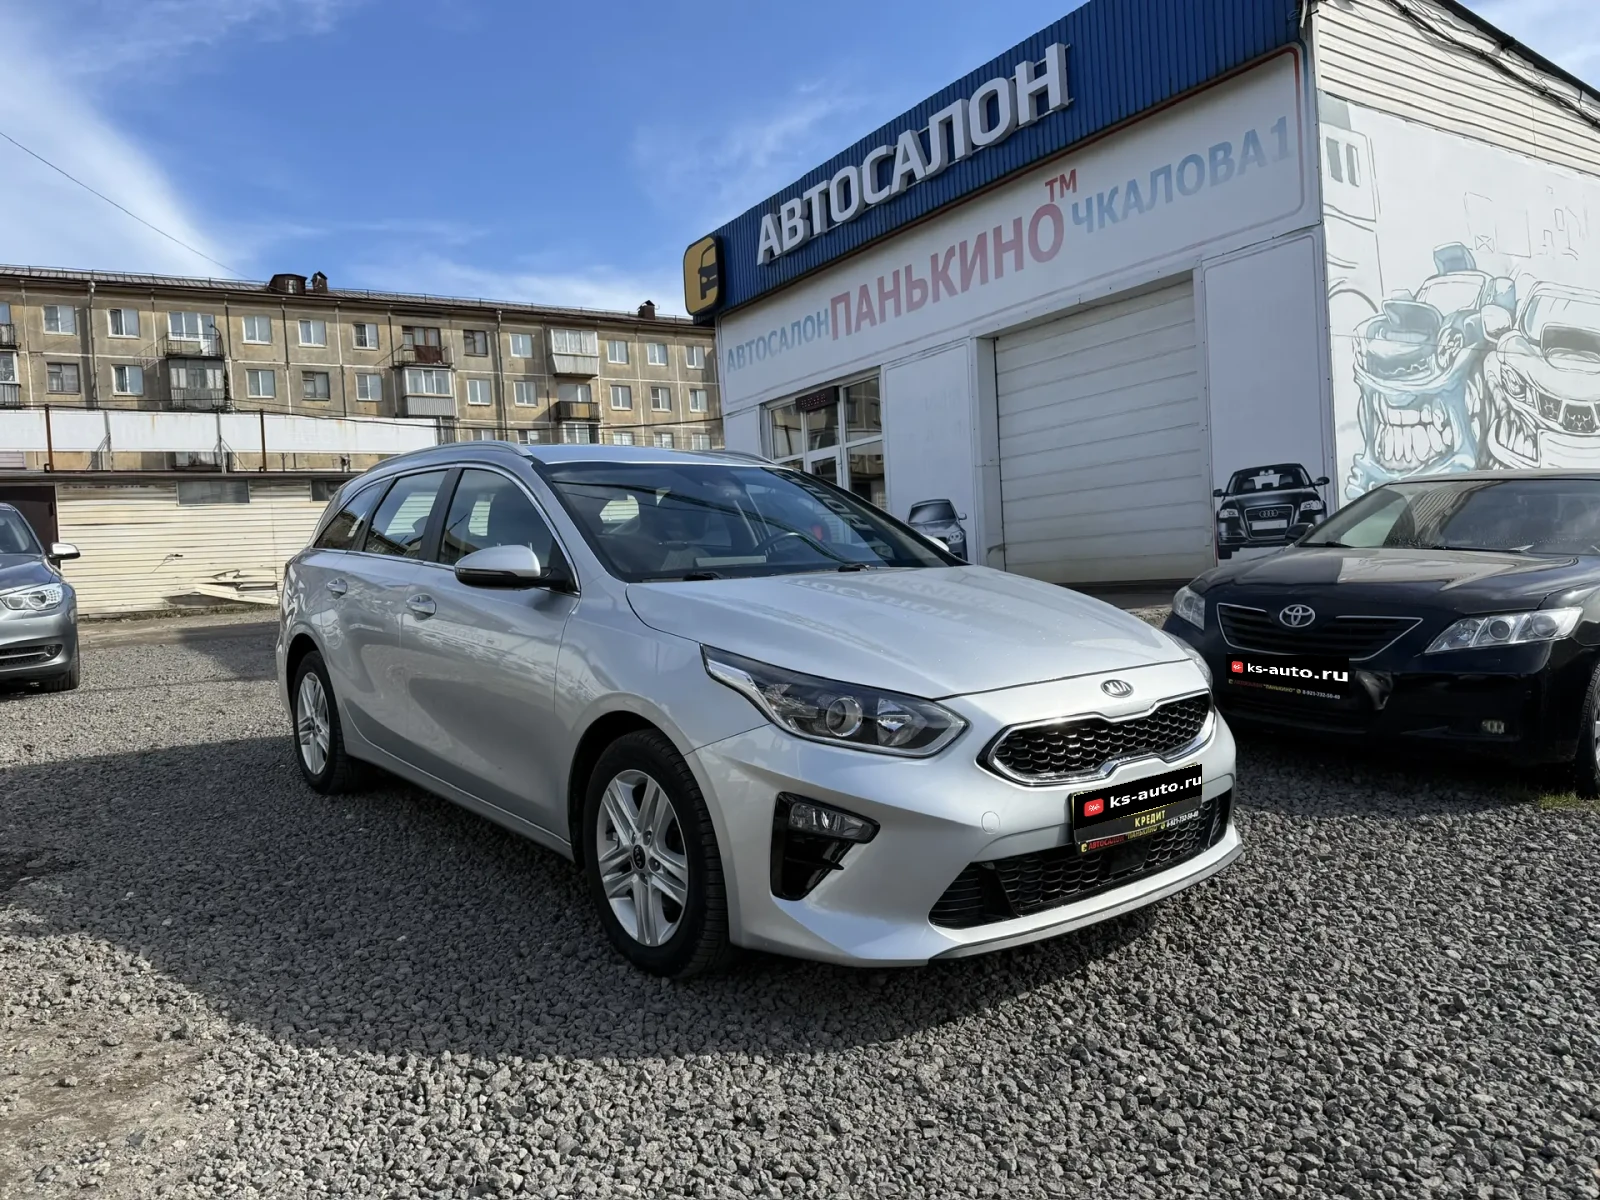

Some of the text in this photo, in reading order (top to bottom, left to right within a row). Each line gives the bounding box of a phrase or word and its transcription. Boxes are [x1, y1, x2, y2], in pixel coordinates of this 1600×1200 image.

[757, 42, 1069, 266] АВТОСАЛОН
[727, 308, 830, 373] АВТОСАЛОН
[830, 203, 1064, 341] ПАНЬКИНО
[1134, 810, 1166, 828] КРЕДИТ
